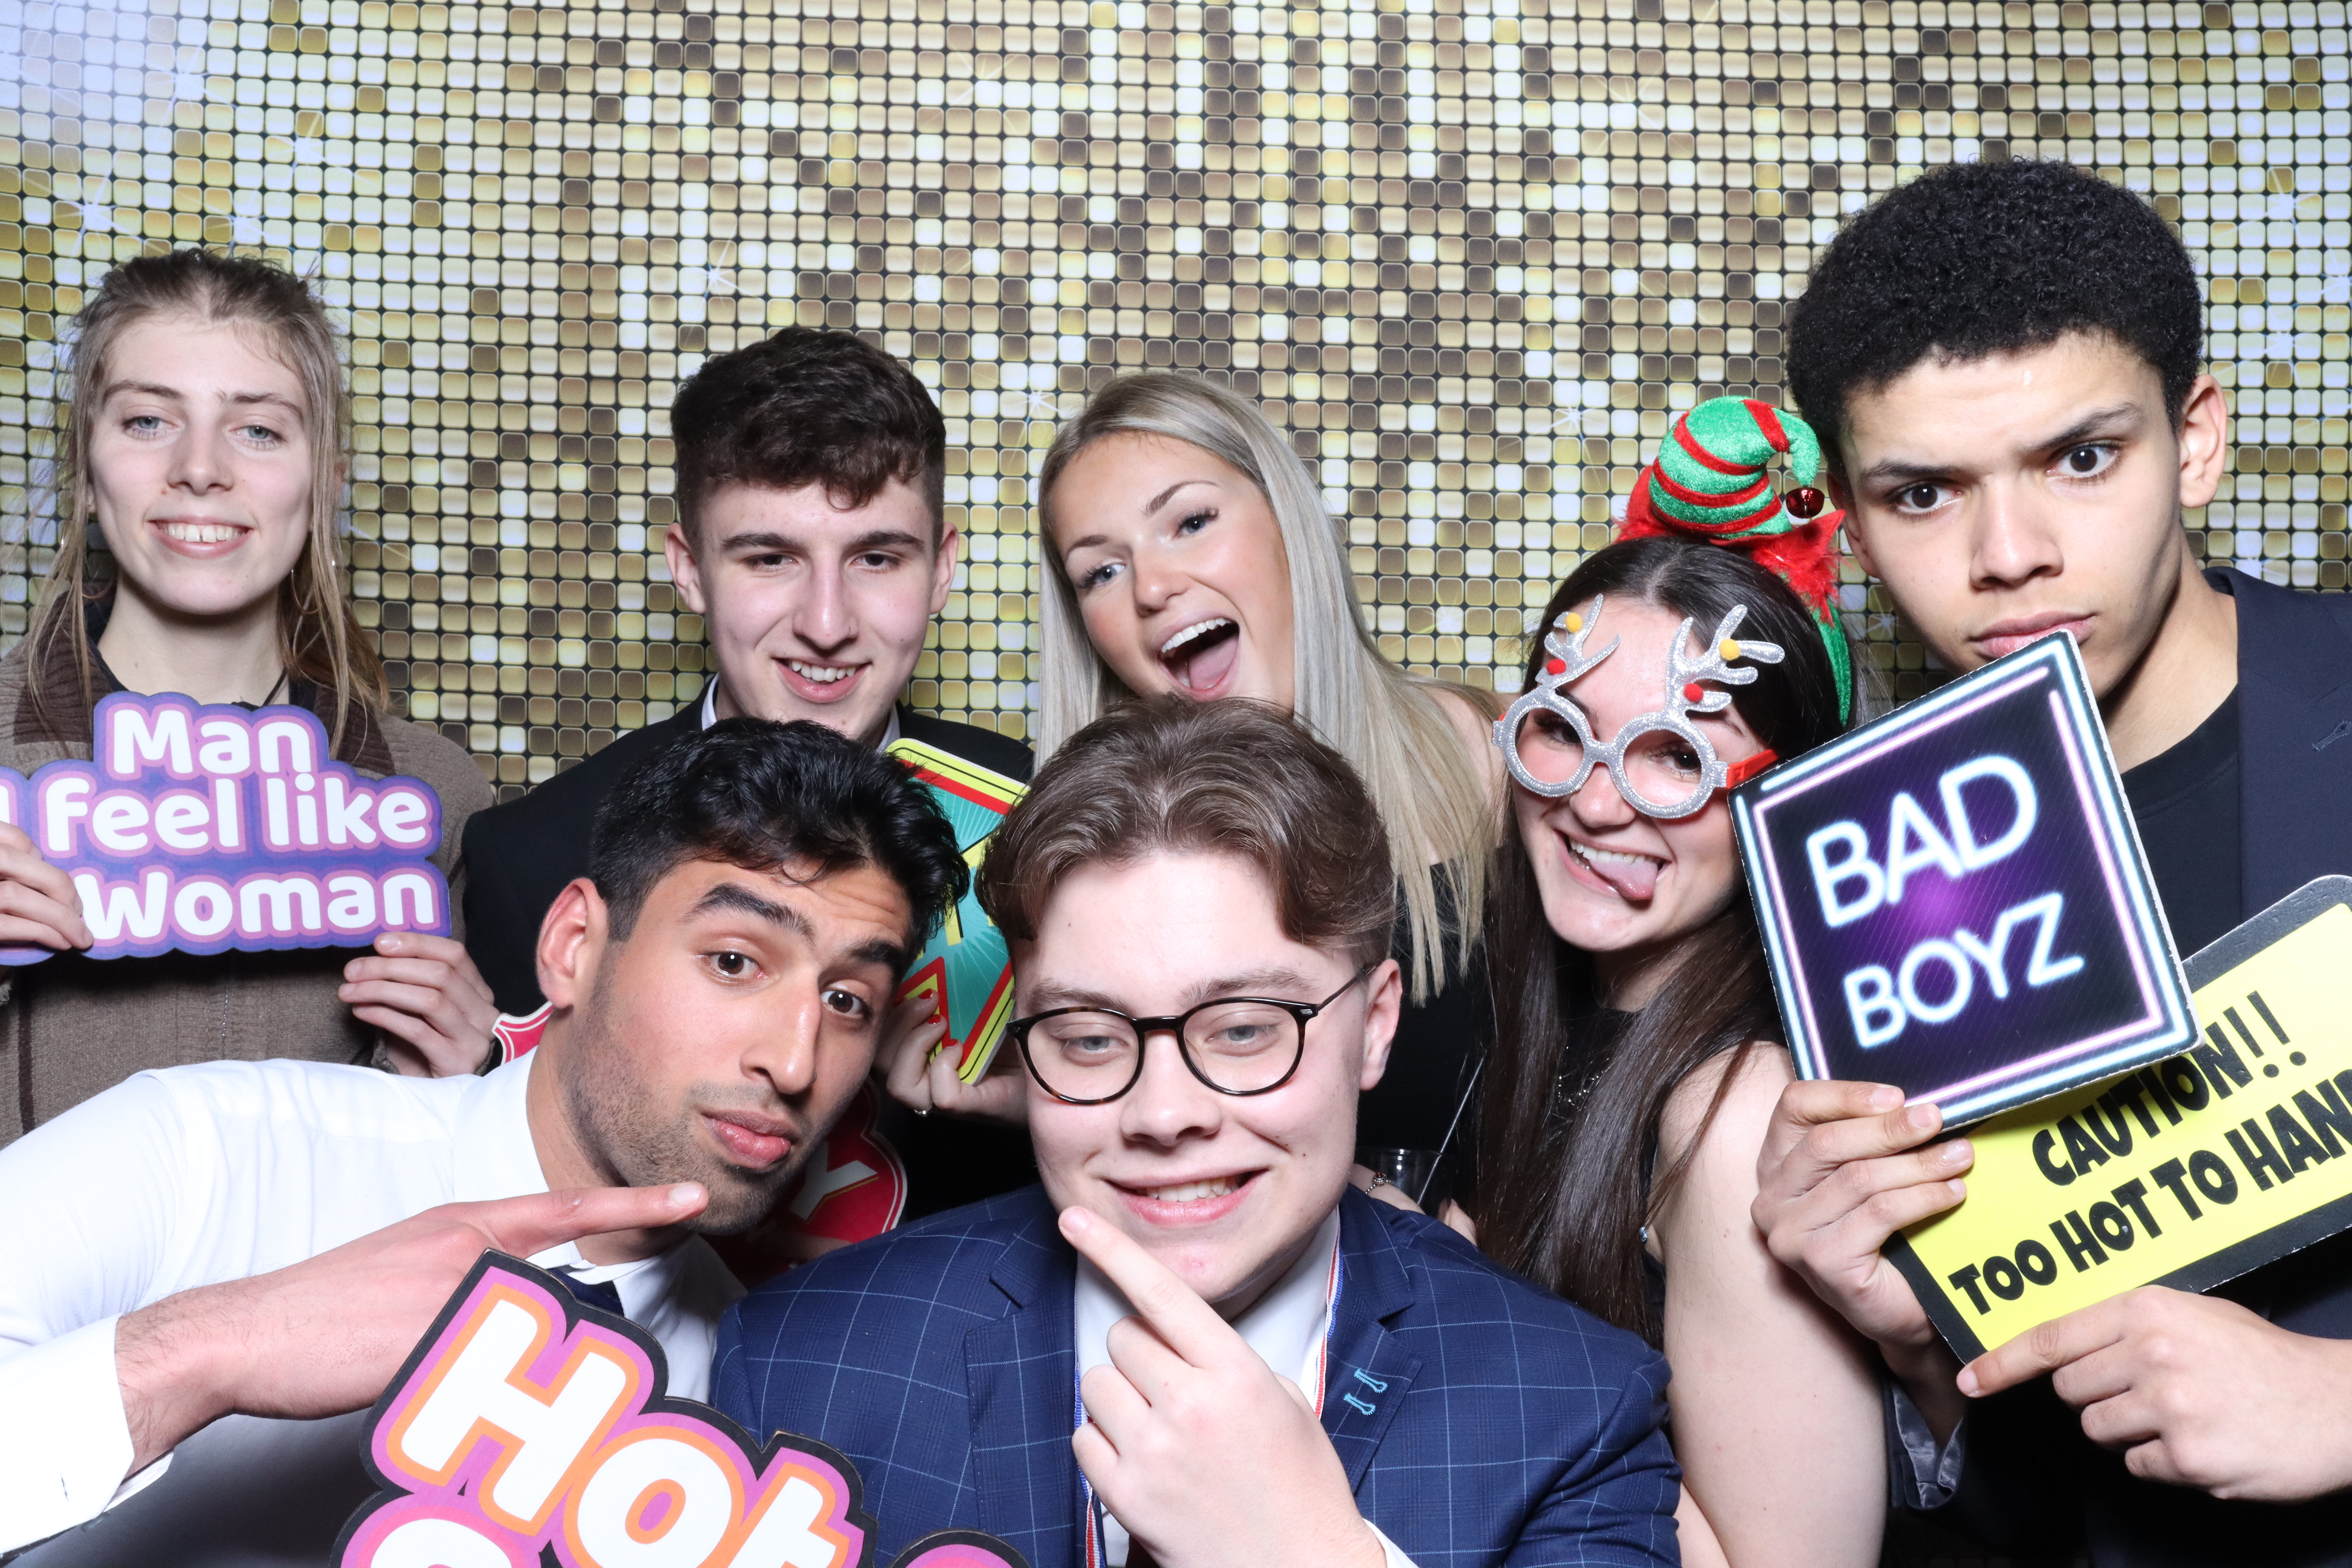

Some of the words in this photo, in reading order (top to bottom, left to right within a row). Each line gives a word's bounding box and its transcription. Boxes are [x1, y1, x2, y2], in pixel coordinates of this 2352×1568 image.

[45, 777, 240, 851] feel
[266, 773, 427, 846] like
[113, 710, 312, 774] Man
[74, 872, 434, 940] Woman
[1806, 755, 2037, 927] BAD
[1843, 892, 2084, 1048] BOYZ
[2032, 990, 2307, 1186] CAUTION!!
[1947, 1239, 2058, 1316] TOO
[2049, 1177, 2163, 1273] HOT
[2149, 1149, 2238, 1221] TO
